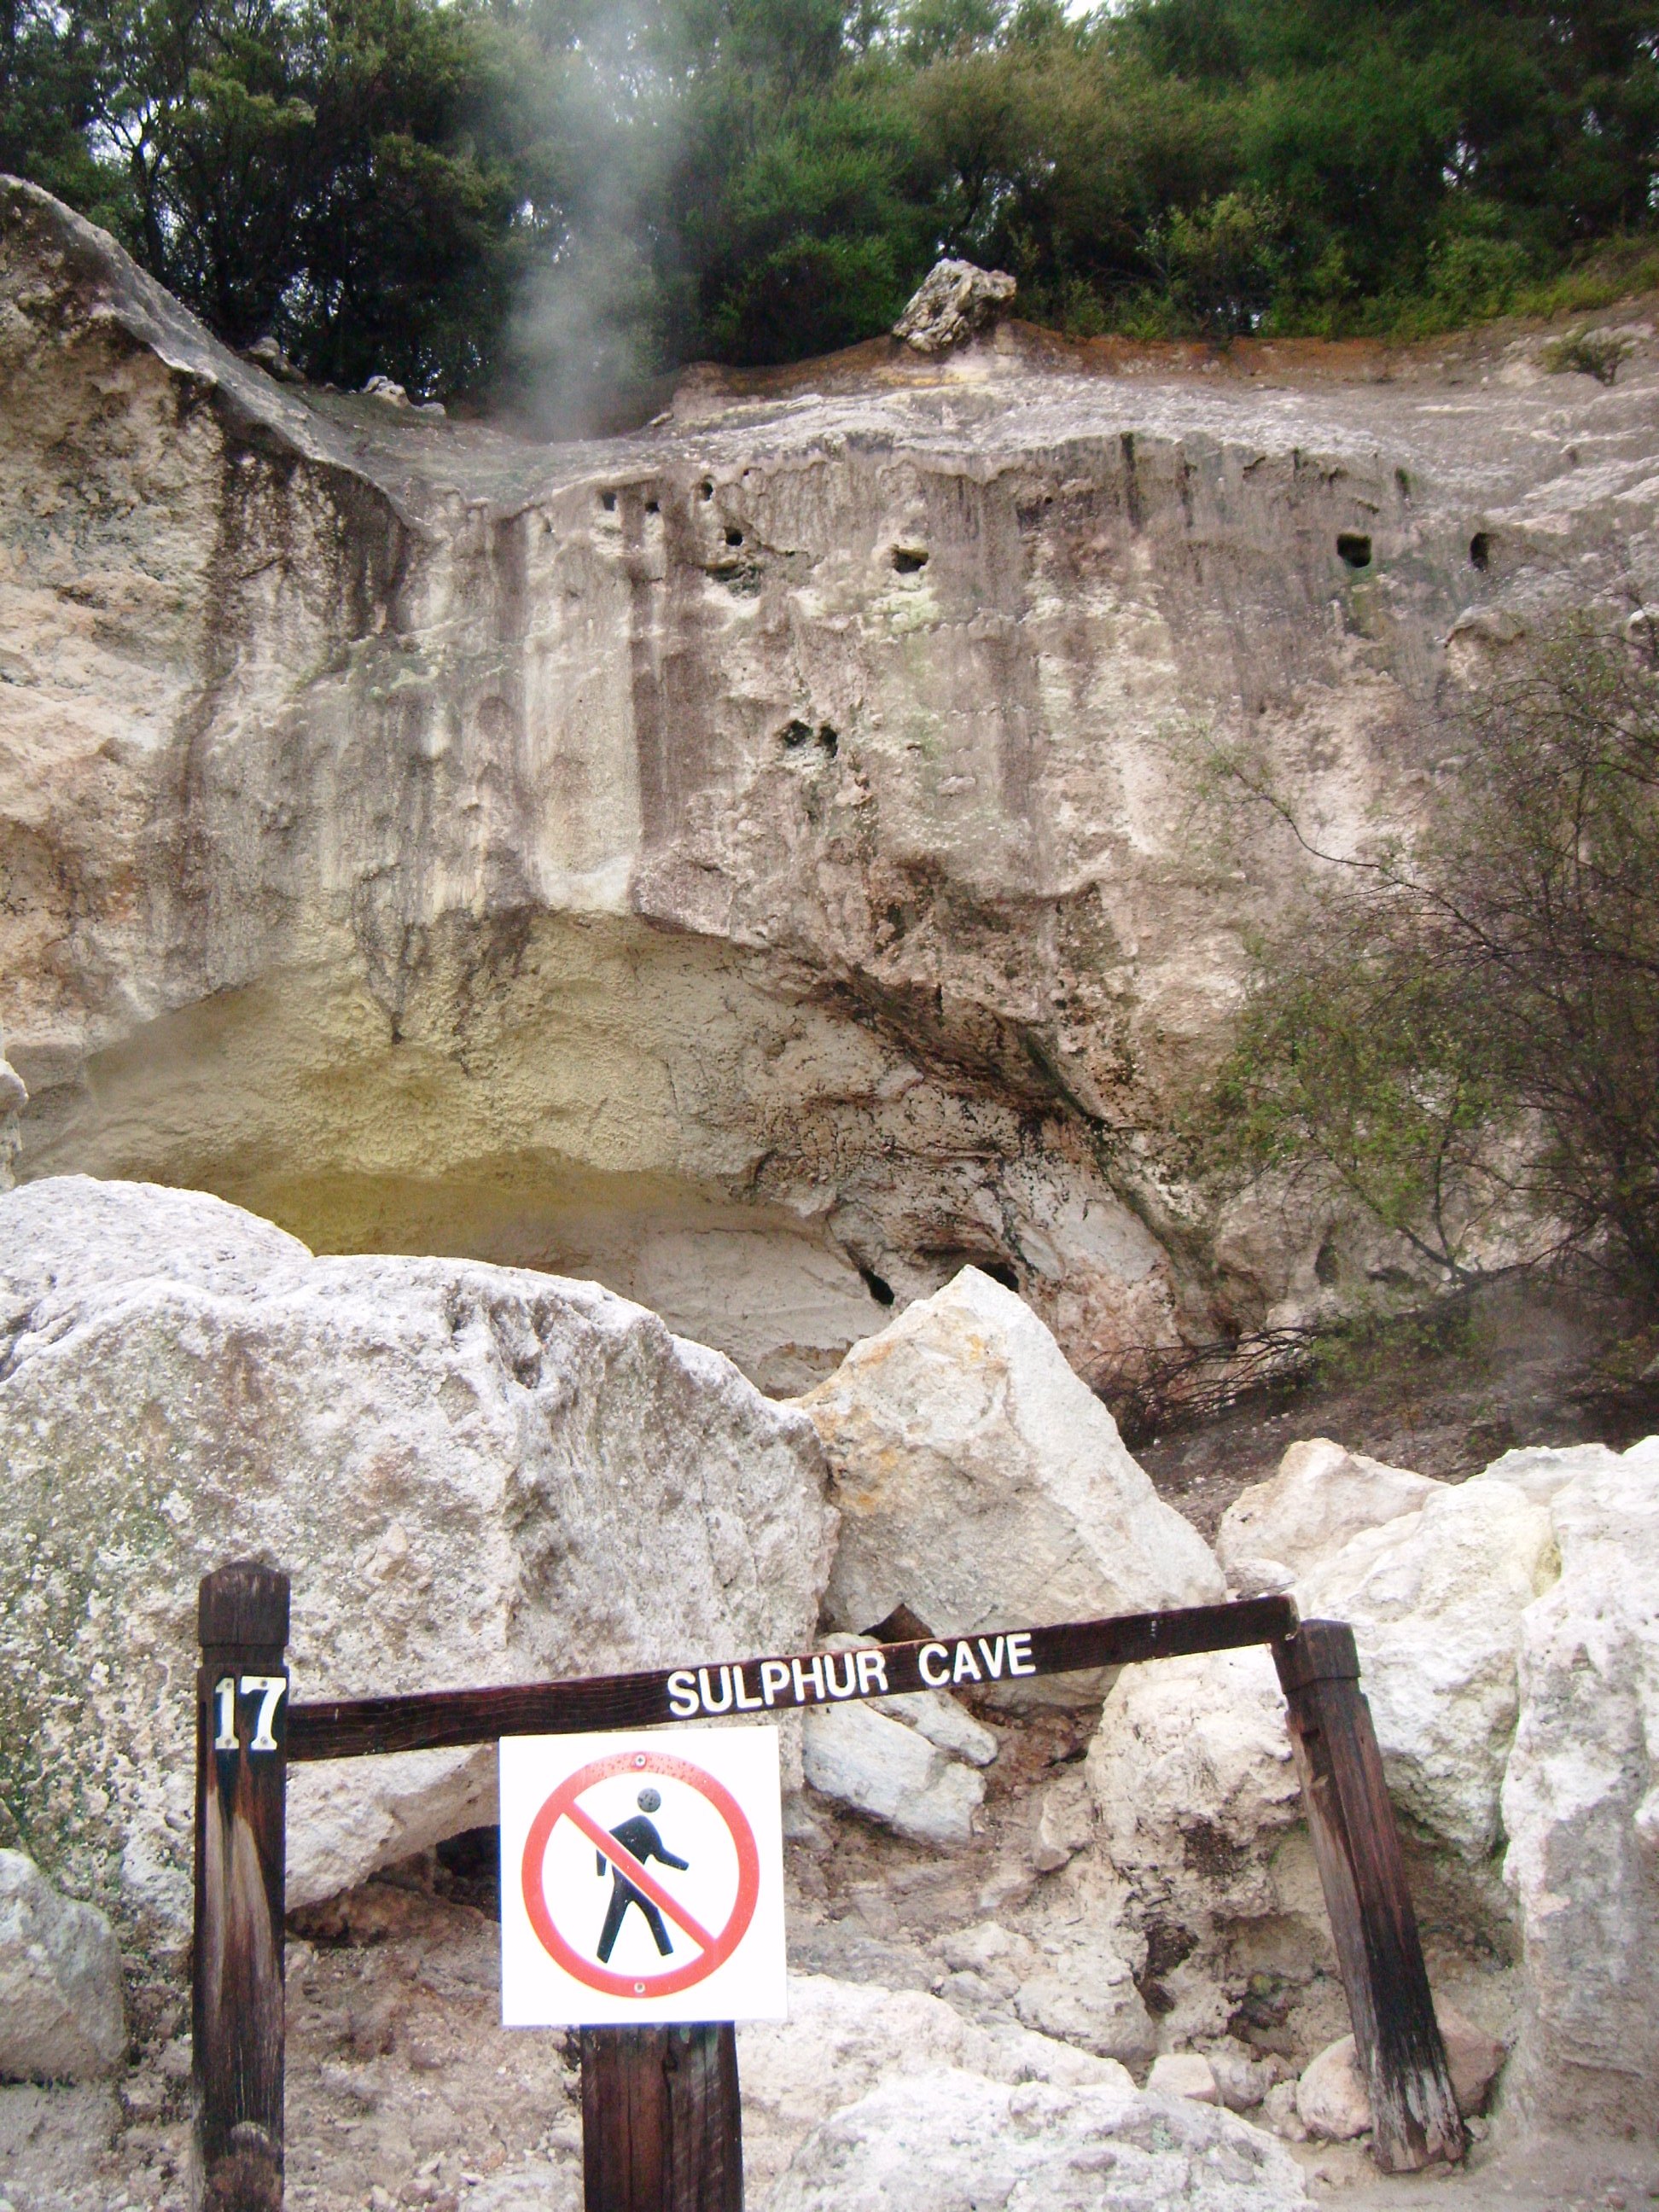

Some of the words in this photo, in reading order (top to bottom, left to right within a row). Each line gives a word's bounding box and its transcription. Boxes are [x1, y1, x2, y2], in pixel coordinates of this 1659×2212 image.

[215, 1676, 287, 1749] 17
[667, 1650, 888, 1716] SULPHUR
[918, 1633, 1036, 1686] CAVE
